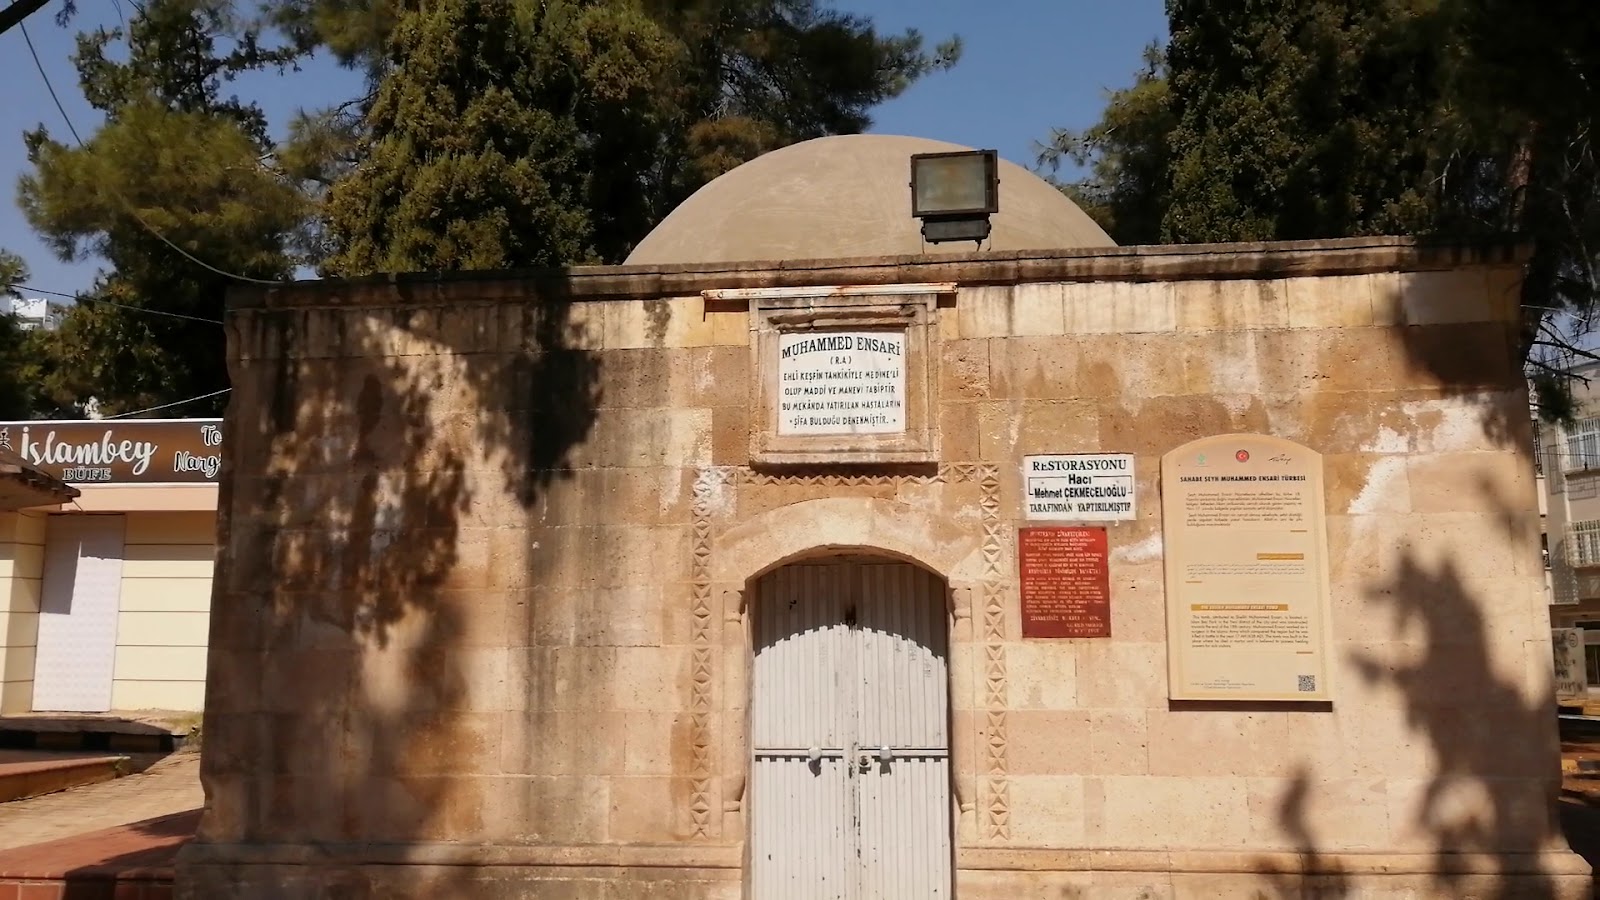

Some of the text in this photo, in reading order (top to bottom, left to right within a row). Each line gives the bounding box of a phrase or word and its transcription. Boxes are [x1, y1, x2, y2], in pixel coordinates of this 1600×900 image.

[781, 336, 853, 359] MUHAMMED
[783, 369, 799, 381] EHLİ
[784, 387, 801, 396] OLUP
[828, 386, 836, 395] VE
[866, 382, 896, 394] TABİPTİR
[782, 402, 791, 411] BU
[826, 401, 859, 410] YATIRILAN
[861, 400, 901, 409] HASTALARIN
[794, 414, 808, 429] ŞİFA
[809, 414, 840, 426] BULDUĞU
[20, 426, 158, 476] İslambey
[174, 450, 222, 478] Narg
[1032, 459, 1127, 471] RESTORASYONU
[61, 466, 112, 481] BÜFE
[1068, 473, 1092, 485] Hacı
[1034, 487, 1063, 499] Mehmet
[1029, 502, 1073, 513] TARAFINDAN
